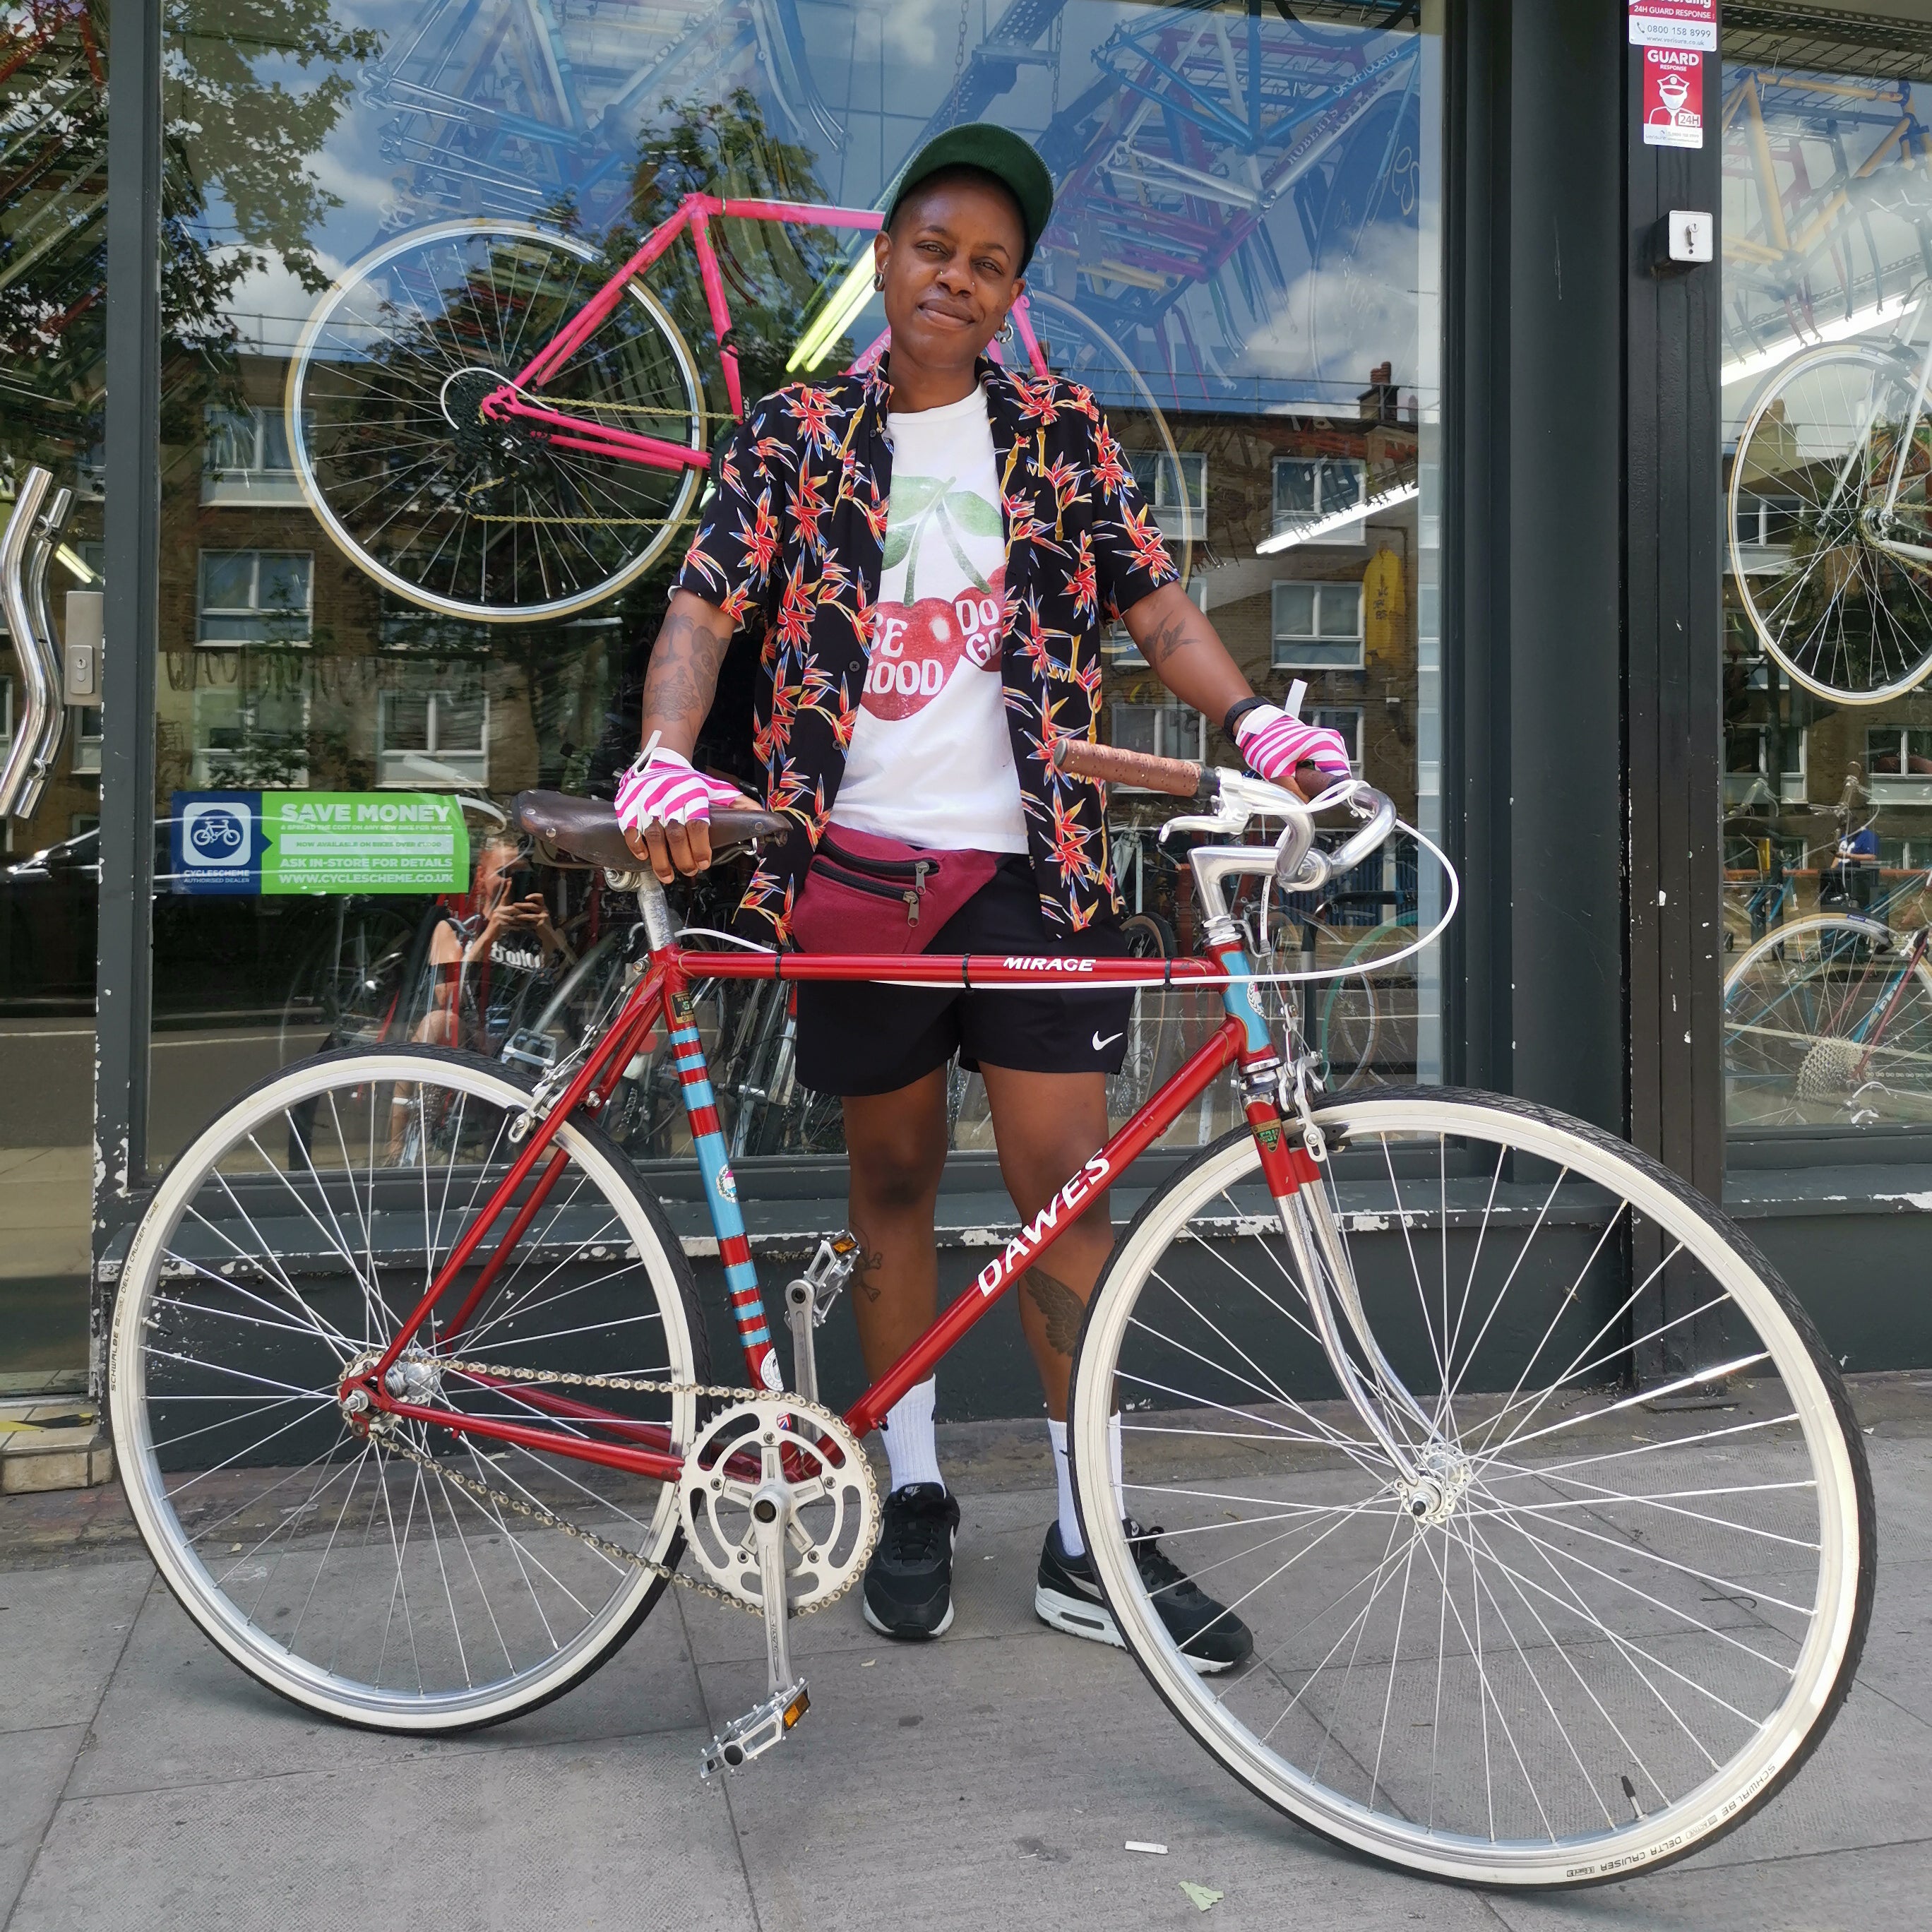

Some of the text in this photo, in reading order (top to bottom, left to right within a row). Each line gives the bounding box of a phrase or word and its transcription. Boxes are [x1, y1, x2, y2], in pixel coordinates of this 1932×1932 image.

[1649, 6, 1674, 16] GUARD
[1676, 8, 1712, 19] RESPONSE
[1647, 25, 1711, 38] 0800 158 8999
[1646, 37, 1705, 46] www.verisure.co.uk
[1647, 49, 1700, 66] GUARD
[1659, 64, 1687, 72] RESPONSE
[1680, 114, 1700, 125] 24H
[955, 599, 1000, 636] DO
[281, 803, 451, 823] SAVE MONEY
[280, 858, 453, 867] ASK IN-STORE FOR DETAILS
[278, 873, 454, 883] WWW.CYCLESCHEME.CO.UK
[1003, 957, 1097, 972] MIRAGE
[977, 1147, 1111, 1297] DAWES
[121, 1266, 132, 1294] DELTA
[130, 1226, 147, 1263] CRUISER
[1722, 1763, 1775, 1817] SCHWALBE
[1650, 1836, 1682, 1856] DELTA
[1600, 1852, 1646, 1871] CRUISER
